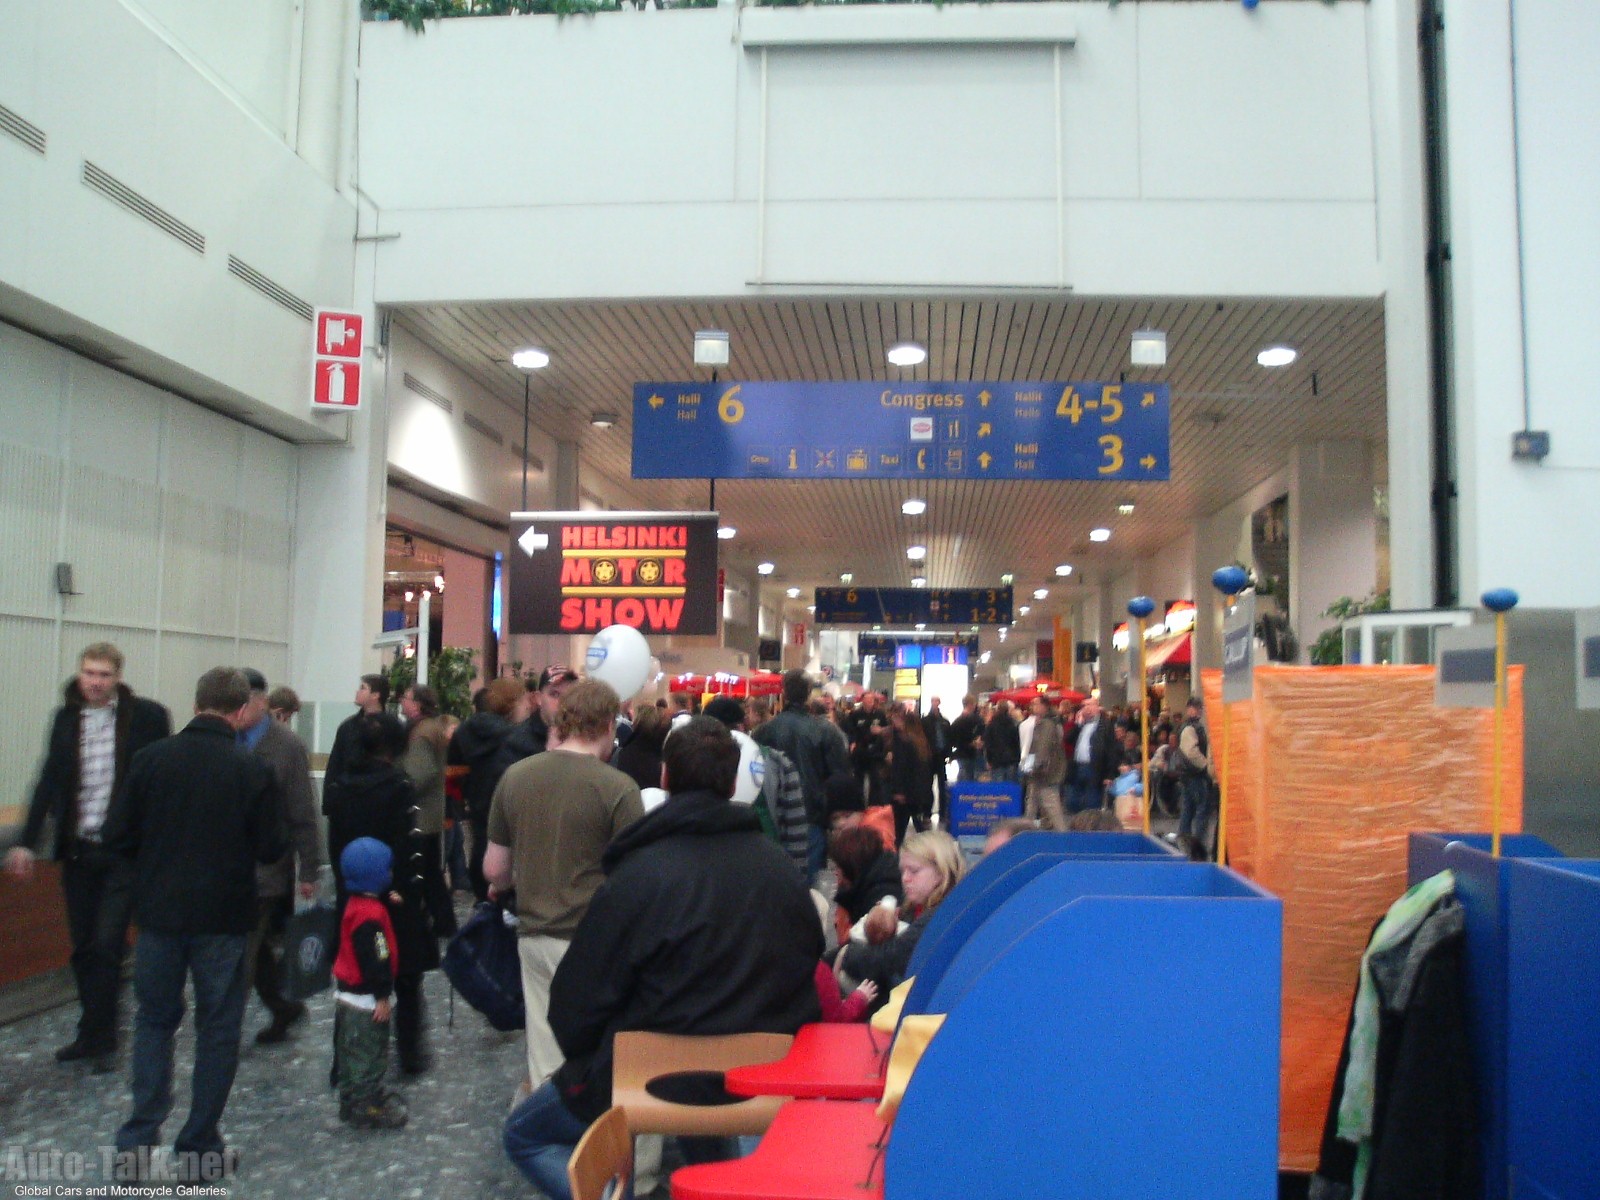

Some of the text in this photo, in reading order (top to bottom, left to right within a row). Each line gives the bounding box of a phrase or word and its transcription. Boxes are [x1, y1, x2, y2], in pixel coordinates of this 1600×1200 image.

[717, 384, 745, 424] 6
[880, 389, 965, 411] Congress
[1055, 385, 1125, 425] 4-5
[1098, 433, 1125, 474] 3
[561, 525, 687, 549] HELSINKI
[560, 557, 687, 586] MOTOR
[559, 597, 686, 632] SHOW
